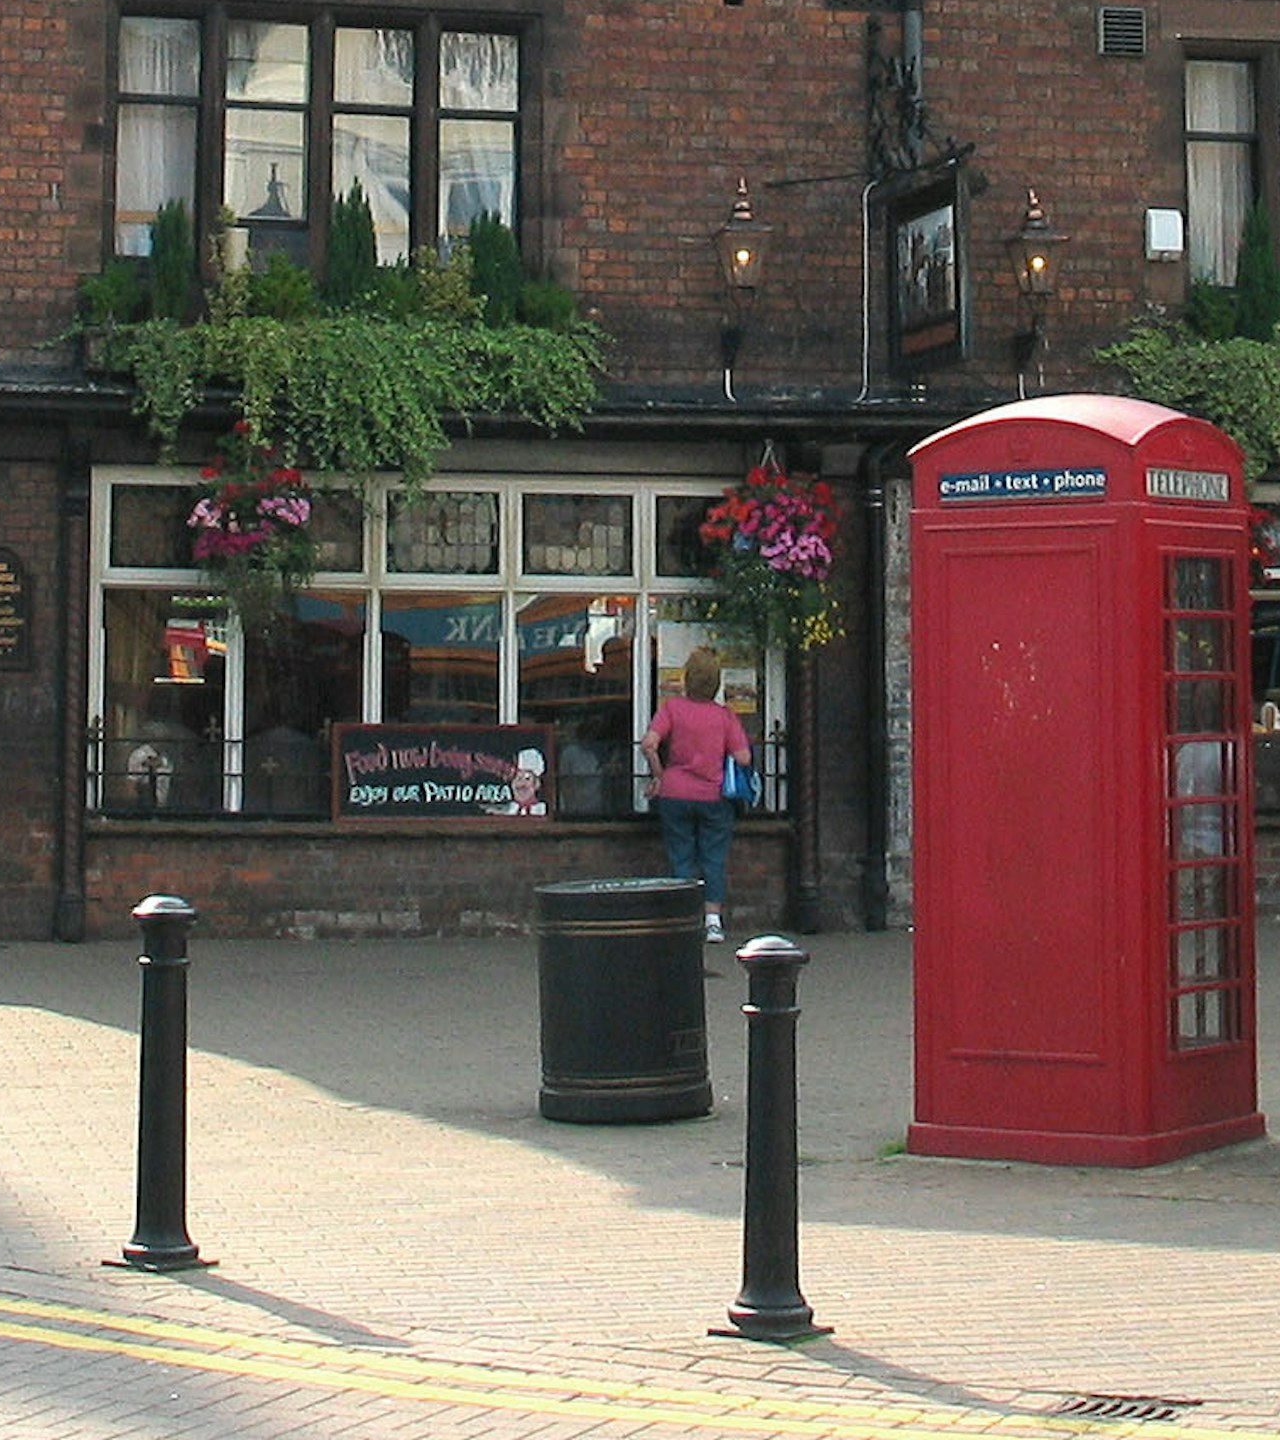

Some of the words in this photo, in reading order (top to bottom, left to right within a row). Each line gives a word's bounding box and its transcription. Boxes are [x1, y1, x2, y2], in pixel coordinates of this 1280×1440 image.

[939, 475, 990, 495] e-mail
[1005, 472, 1039, 491] text
[1053, 469, 1106, 492] phone
[1148, 468, 1229, 501] TELEPHONE
[423, 780, 474, 803] PATIO
